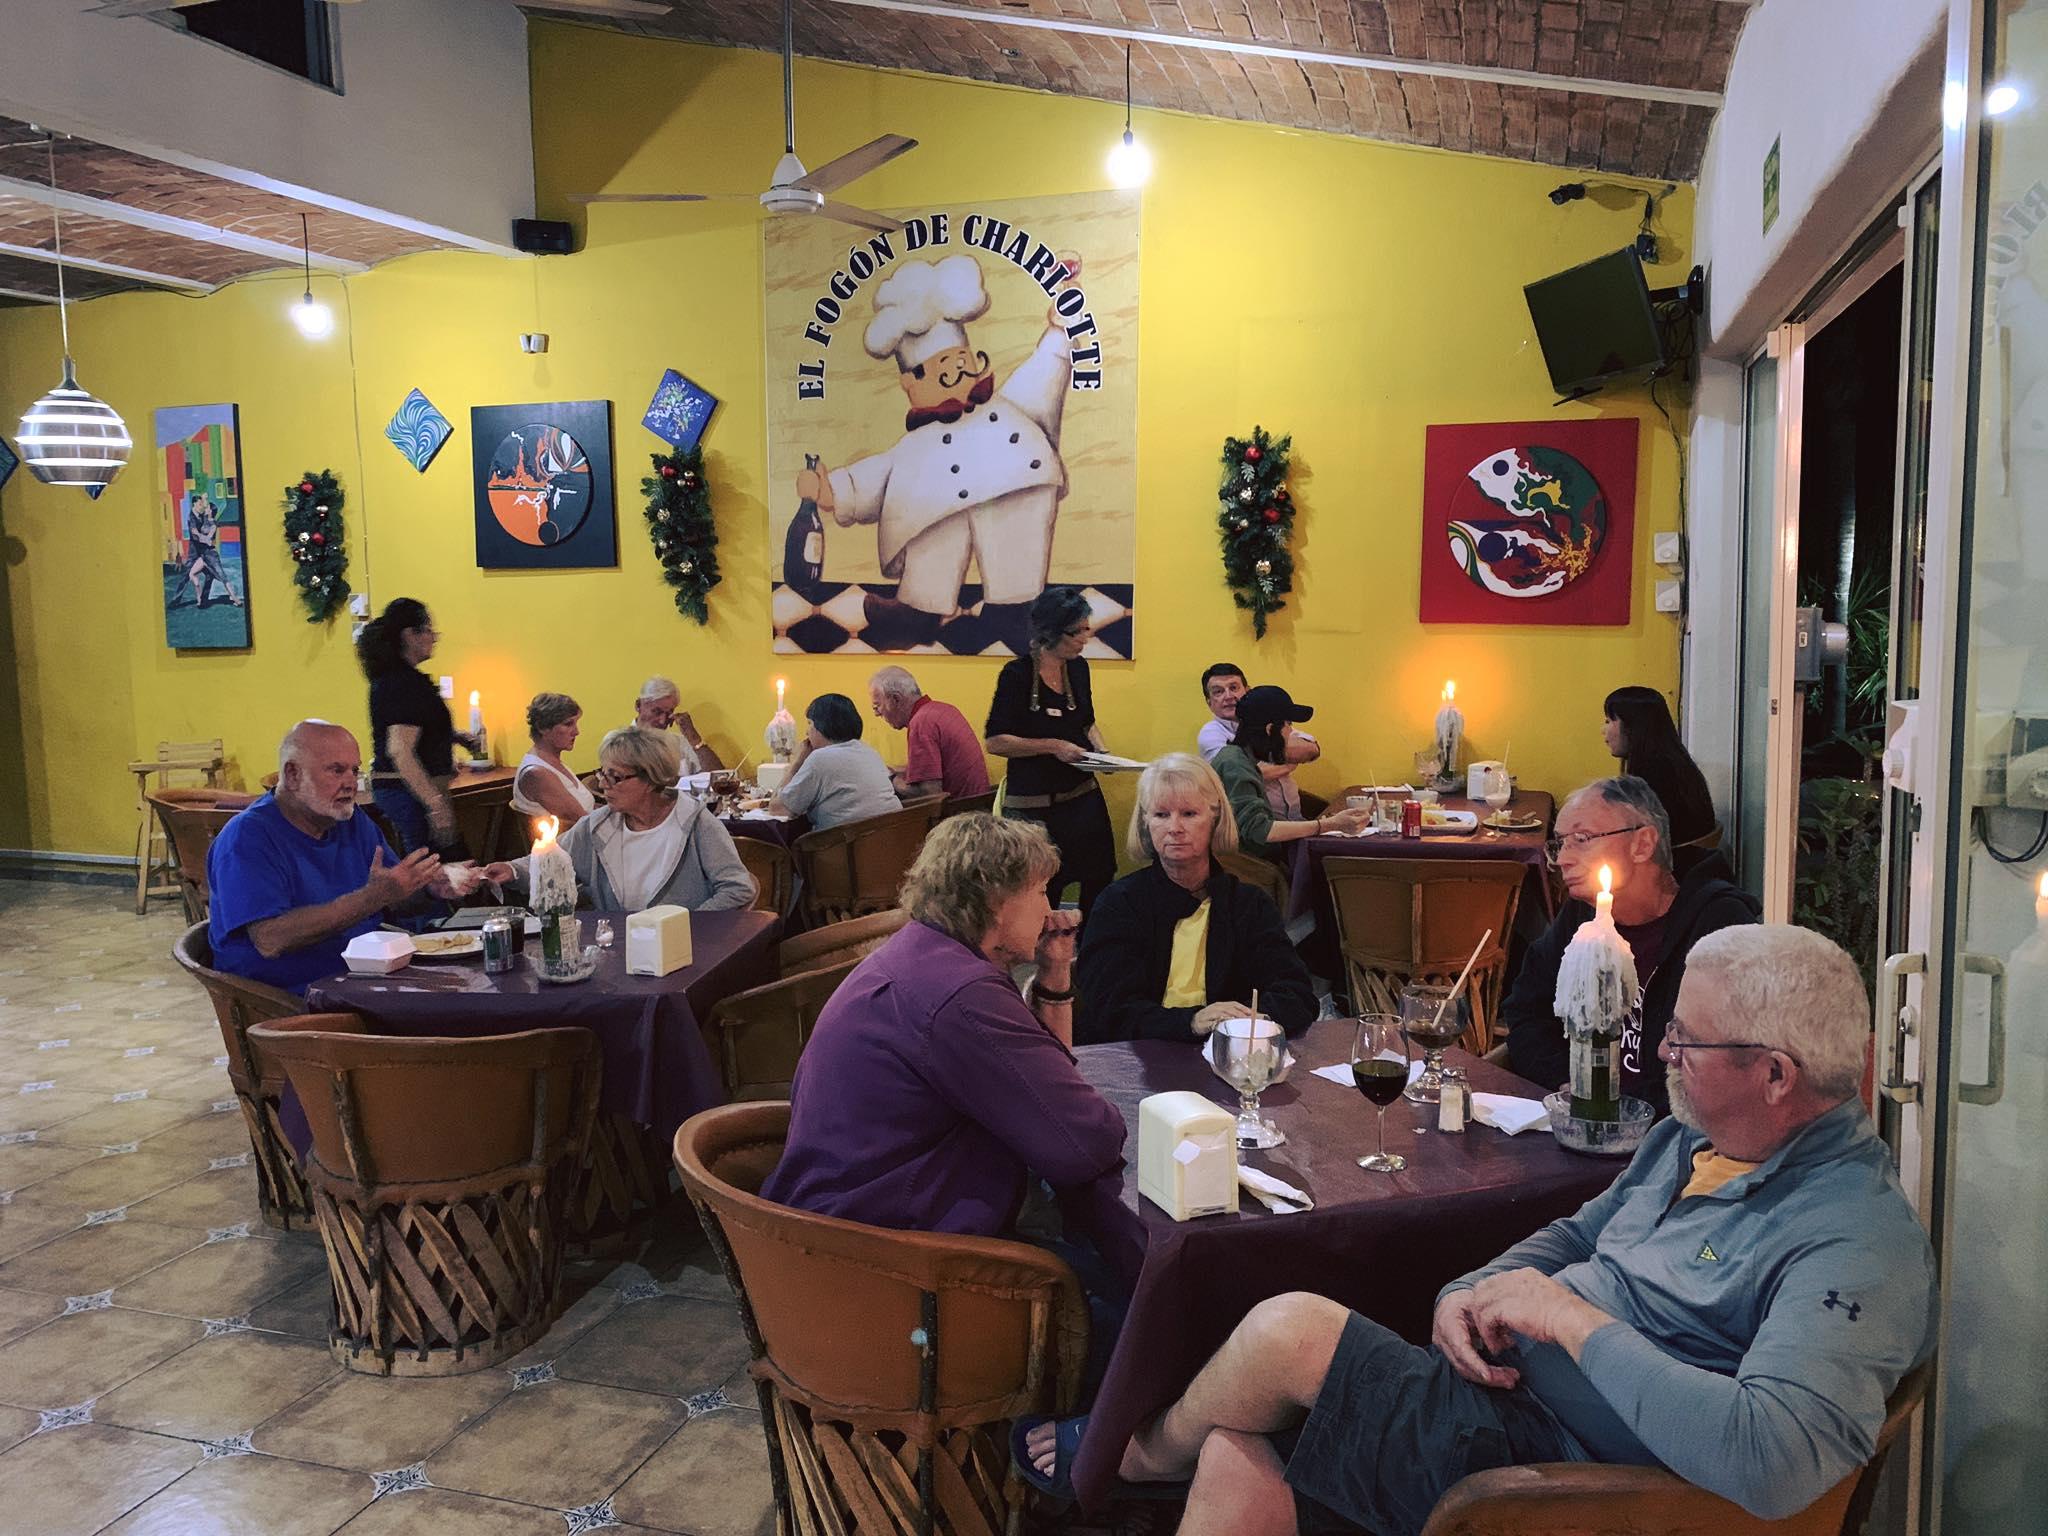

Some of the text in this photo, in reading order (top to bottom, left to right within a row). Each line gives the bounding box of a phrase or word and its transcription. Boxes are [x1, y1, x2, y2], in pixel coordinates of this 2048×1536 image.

[798, 213, 1102, 401] EL FOGÓN DE CHARLOTTE
